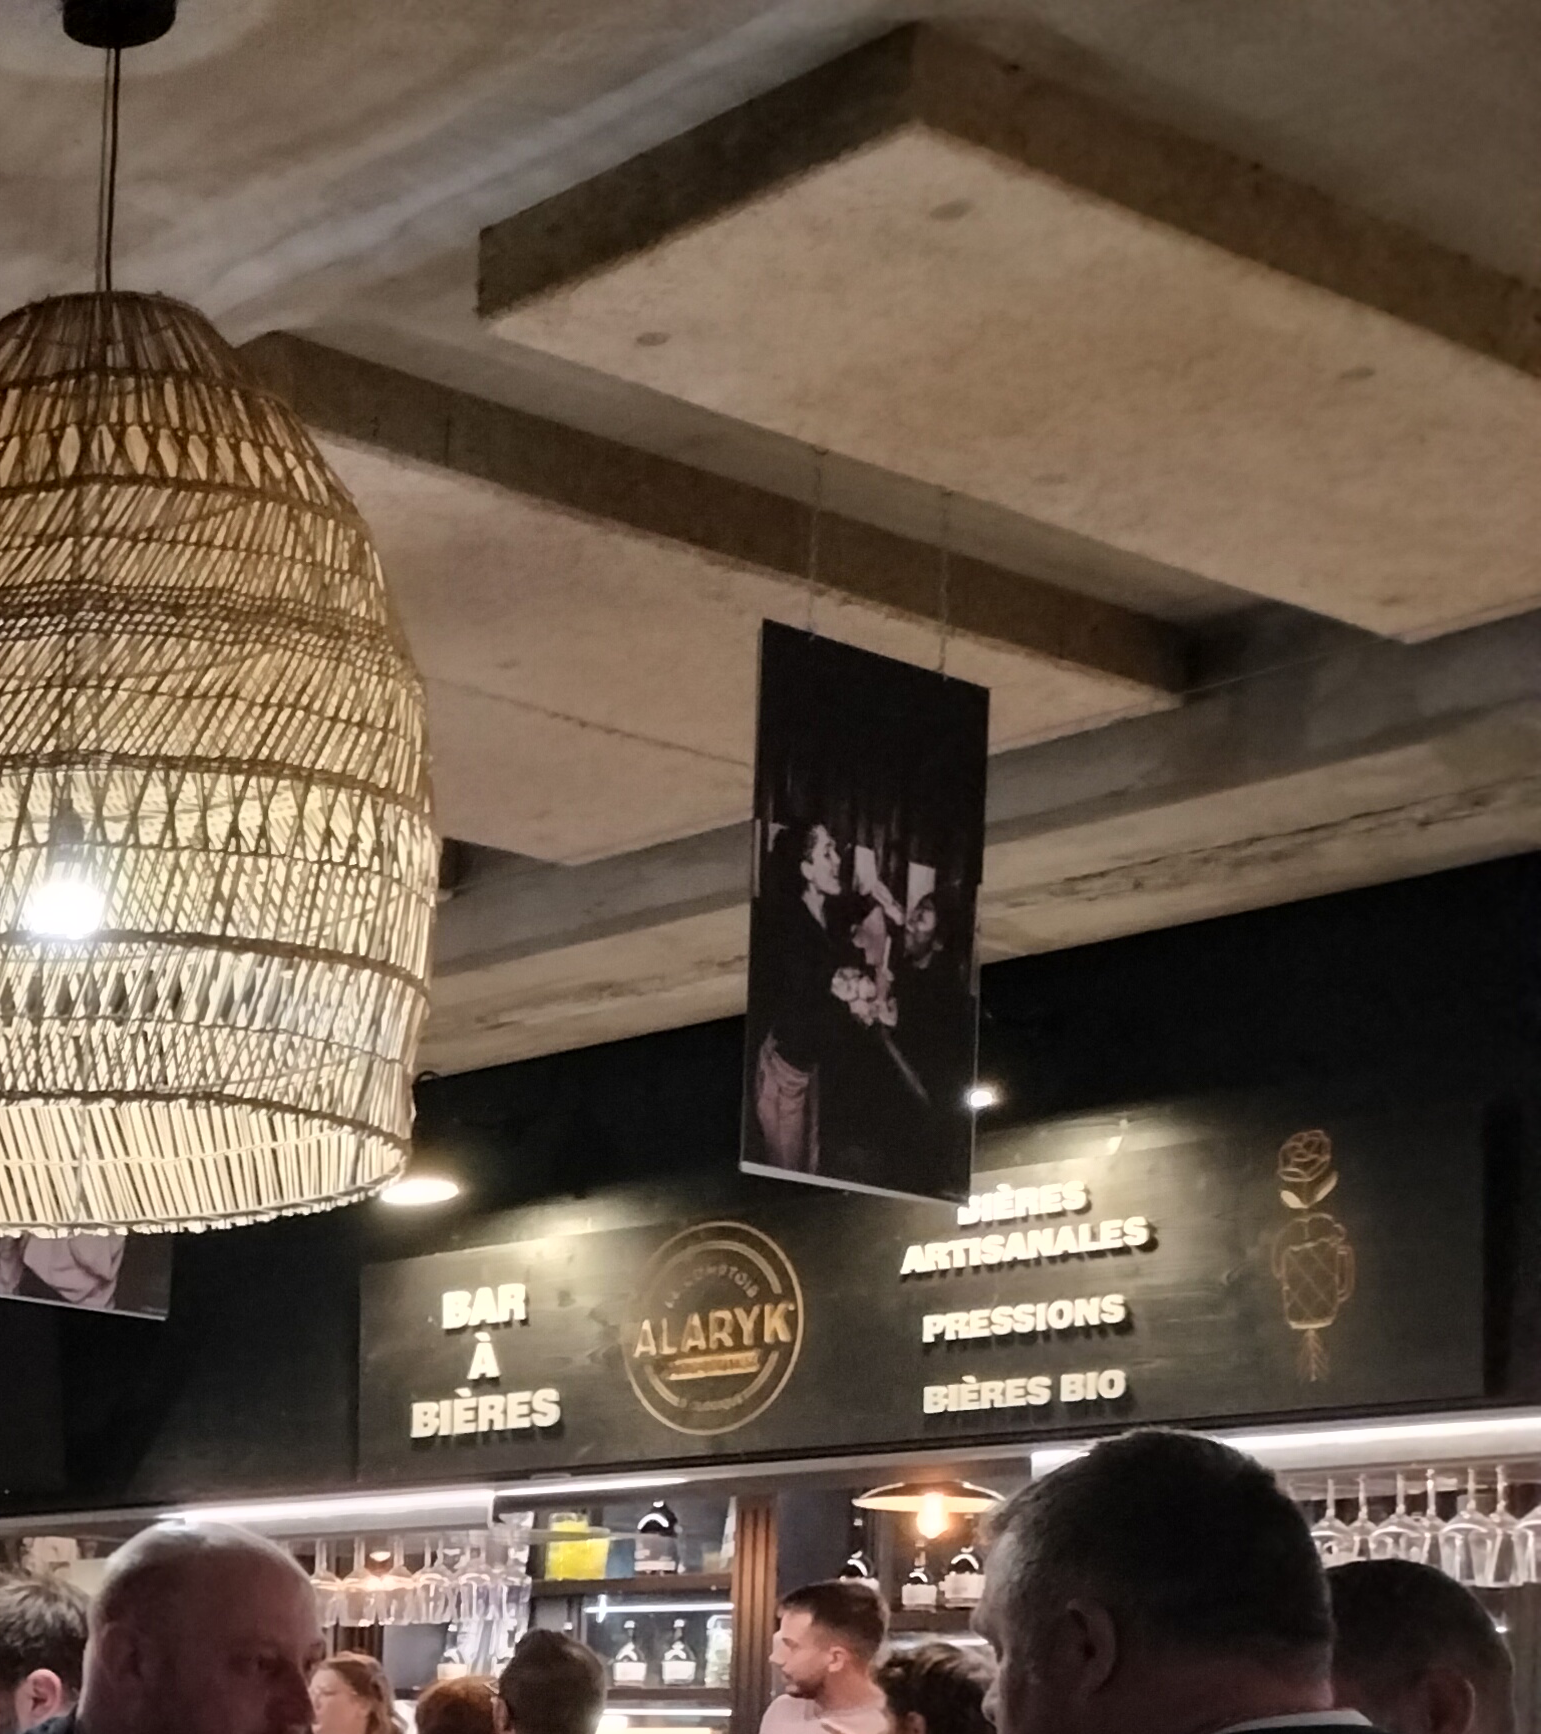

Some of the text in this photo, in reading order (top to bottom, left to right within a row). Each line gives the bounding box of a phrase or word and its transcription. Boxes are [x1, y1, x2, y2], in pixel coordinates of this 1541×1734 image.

[957, 1180, 1087, 1225] BIÈRES
[900, 1216, 1151, 1275] ARTISANALES
[442, 1283, 527, 1330] BAR
[633, 1303, 795, 1358] ALARYK
[922, 1294, 1126, 1343] PRESSIONS
[467, 1331, 501, 1380] À
[410, 1387, 562, 1438] BIÈRES
[923, 1369, 1127, 1414] BIÈRES BIO
